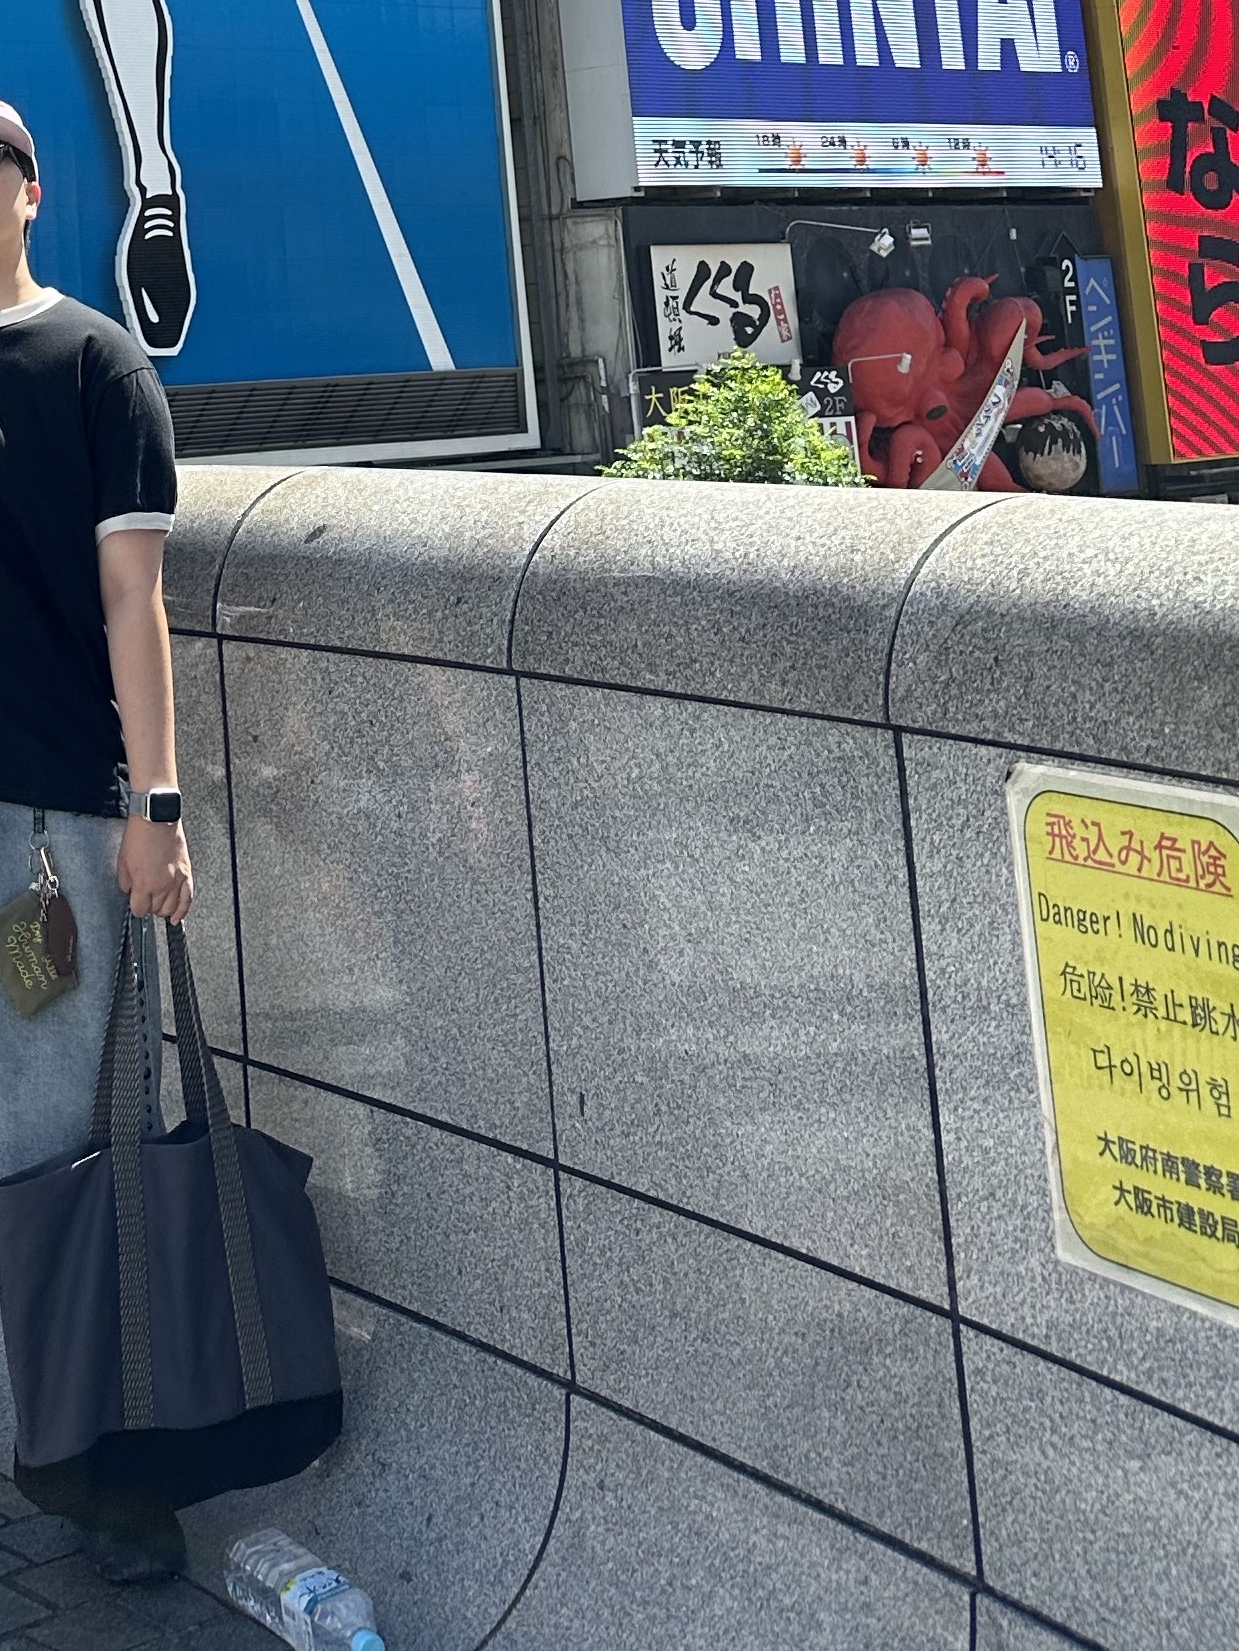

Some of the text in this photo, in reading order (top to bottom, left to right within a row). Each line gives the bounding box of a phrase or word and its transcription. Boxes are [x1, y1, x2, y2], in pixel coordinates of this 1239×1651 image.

[652, 139, 723, 169] 天気予報
[661, 258, 686, 356] 道頓堀
[682, 260, 771, 349] くくる
[1062, 259, 1077, 324] 2F
[810, 370, 844, 394] くくる
[823, 396, 848, 416] 2F
[1085, 277, 1127, 469] ペンギンバー
[1045, 811, 1232, 893] 飛込み危険
[1037, 891, 1123, 938] Danger!
[5, 935, 33, 990] Made
[1096, 1130, 1239, 1201] 大阪府南警察署
[1112, 1180, 1239, 1249] 大阪市建設局
